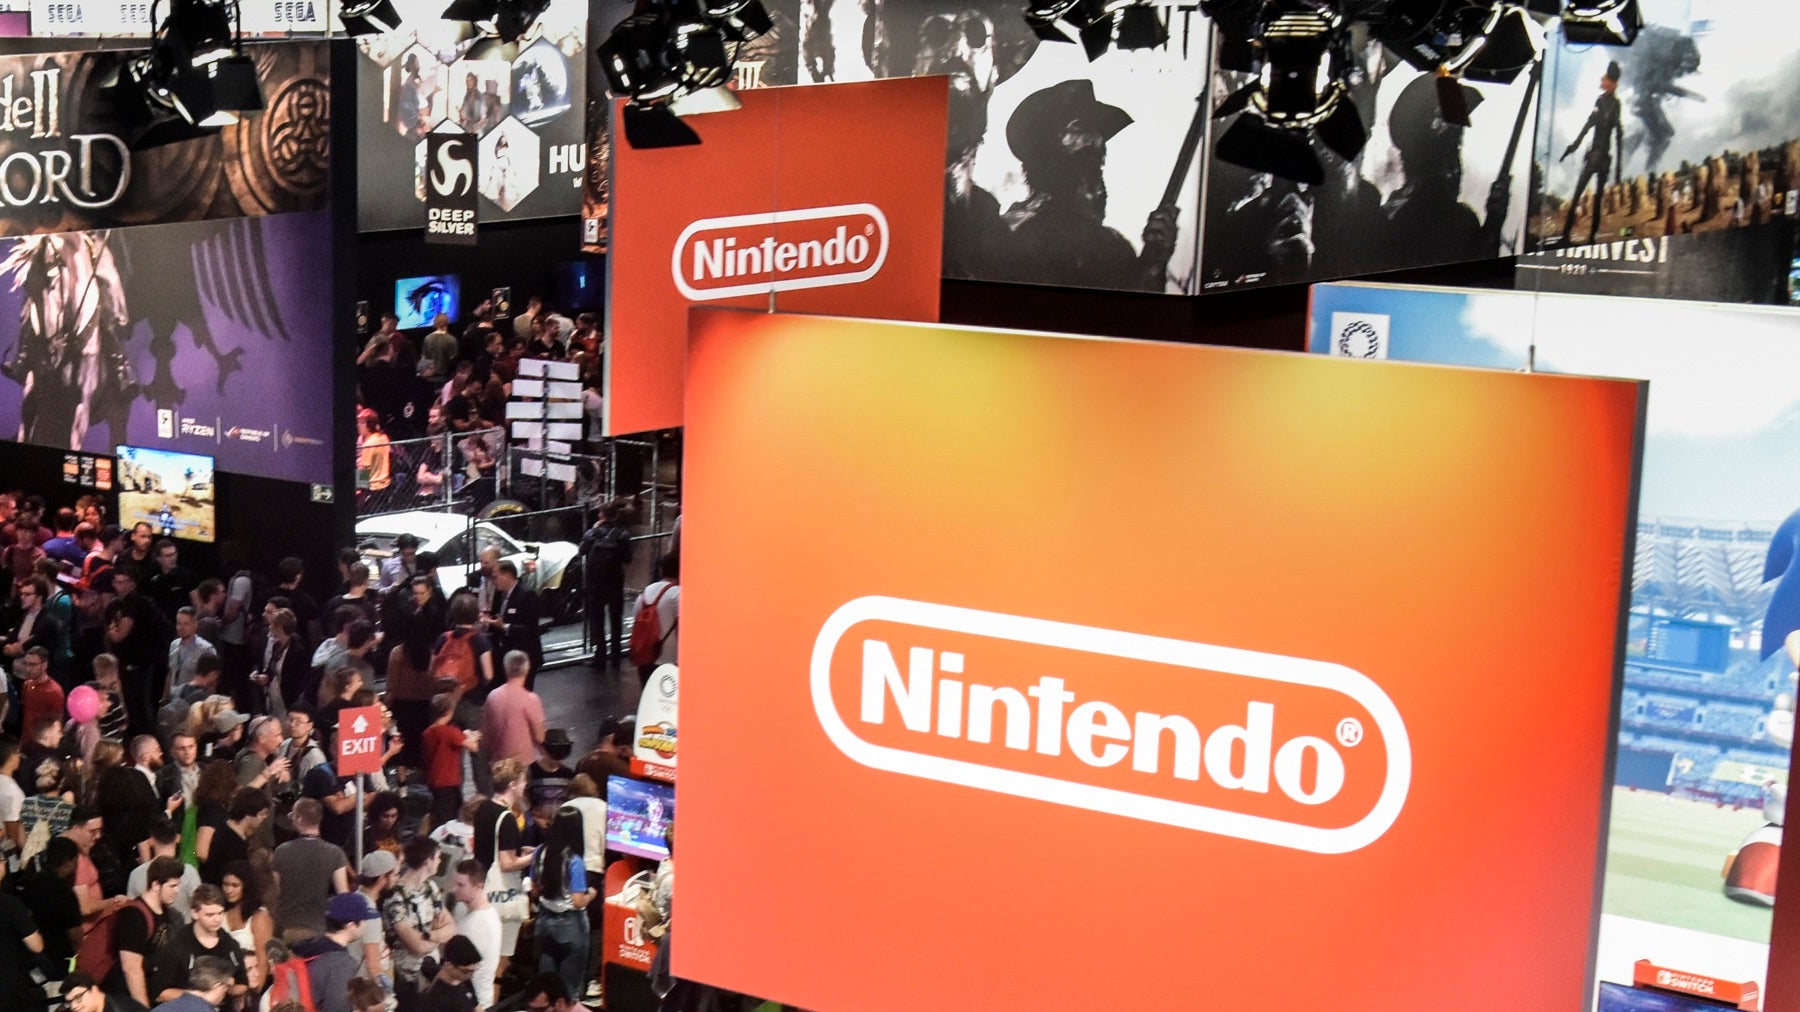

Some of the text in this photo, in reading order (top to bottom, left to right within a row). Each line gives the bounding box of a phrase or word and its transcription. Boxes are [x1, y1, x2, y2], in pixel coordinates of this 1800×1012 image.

[274, 2, 315, 23] SEGA
[428, 208, 475, 222] DEEP
[428, 221, 475, 235] SILVER
[341, 736, 378, 756] EXIT
